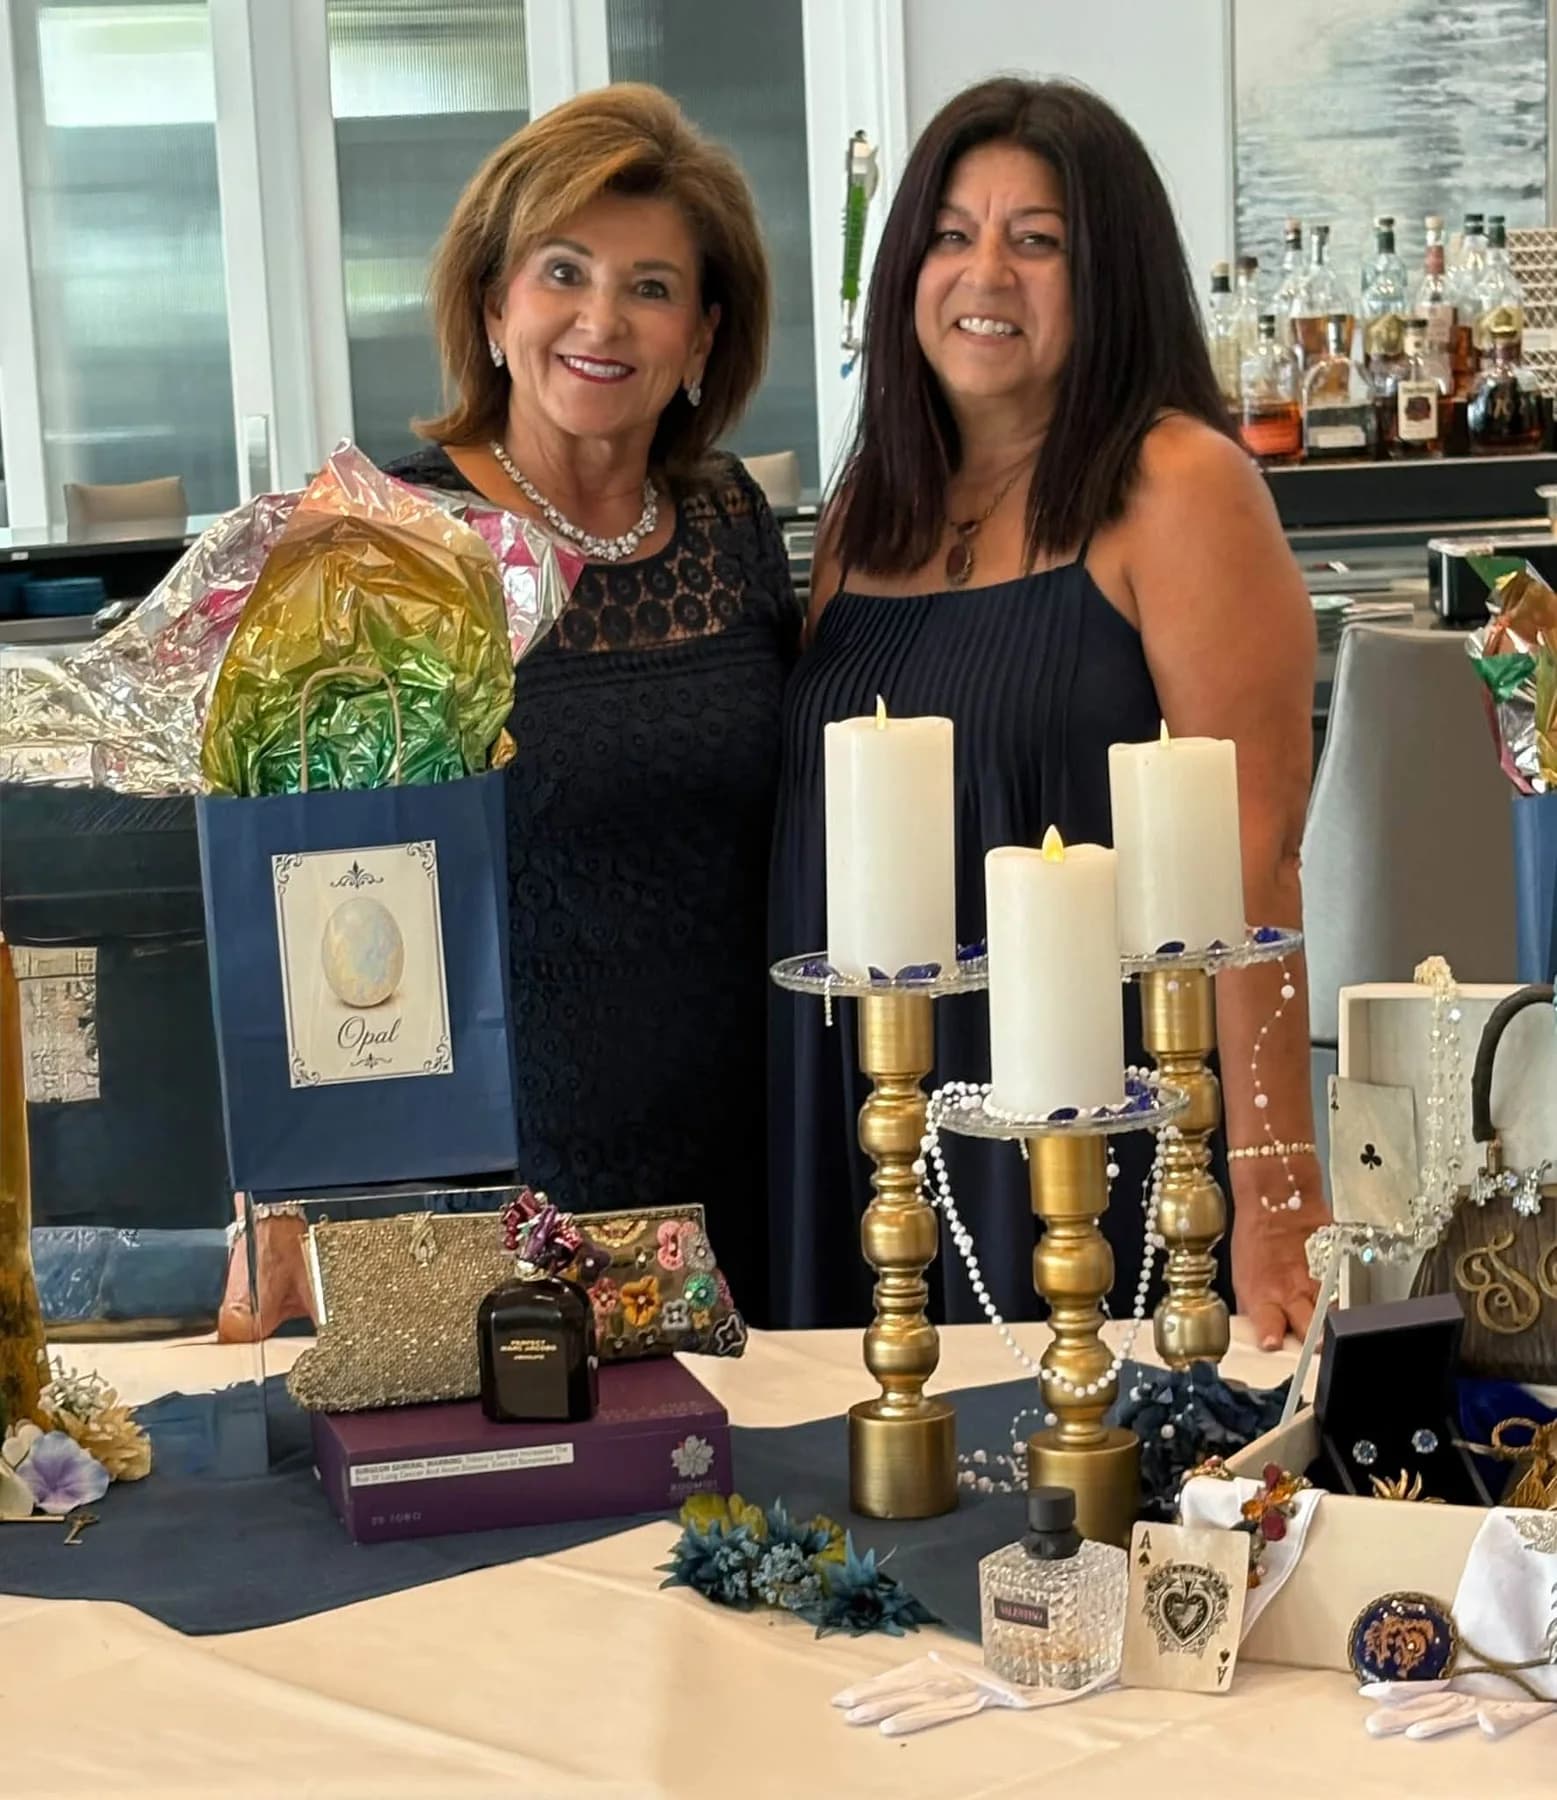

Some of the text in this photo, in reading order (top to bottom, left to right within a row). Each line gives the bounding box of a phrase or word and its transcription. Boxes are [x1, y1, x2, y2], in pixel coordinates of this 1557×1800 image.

[337, 1015, 401, 1056] Opal
[1139, 1530, 1152, 1549] A
[1217, 1666, 1229, 1685] A
